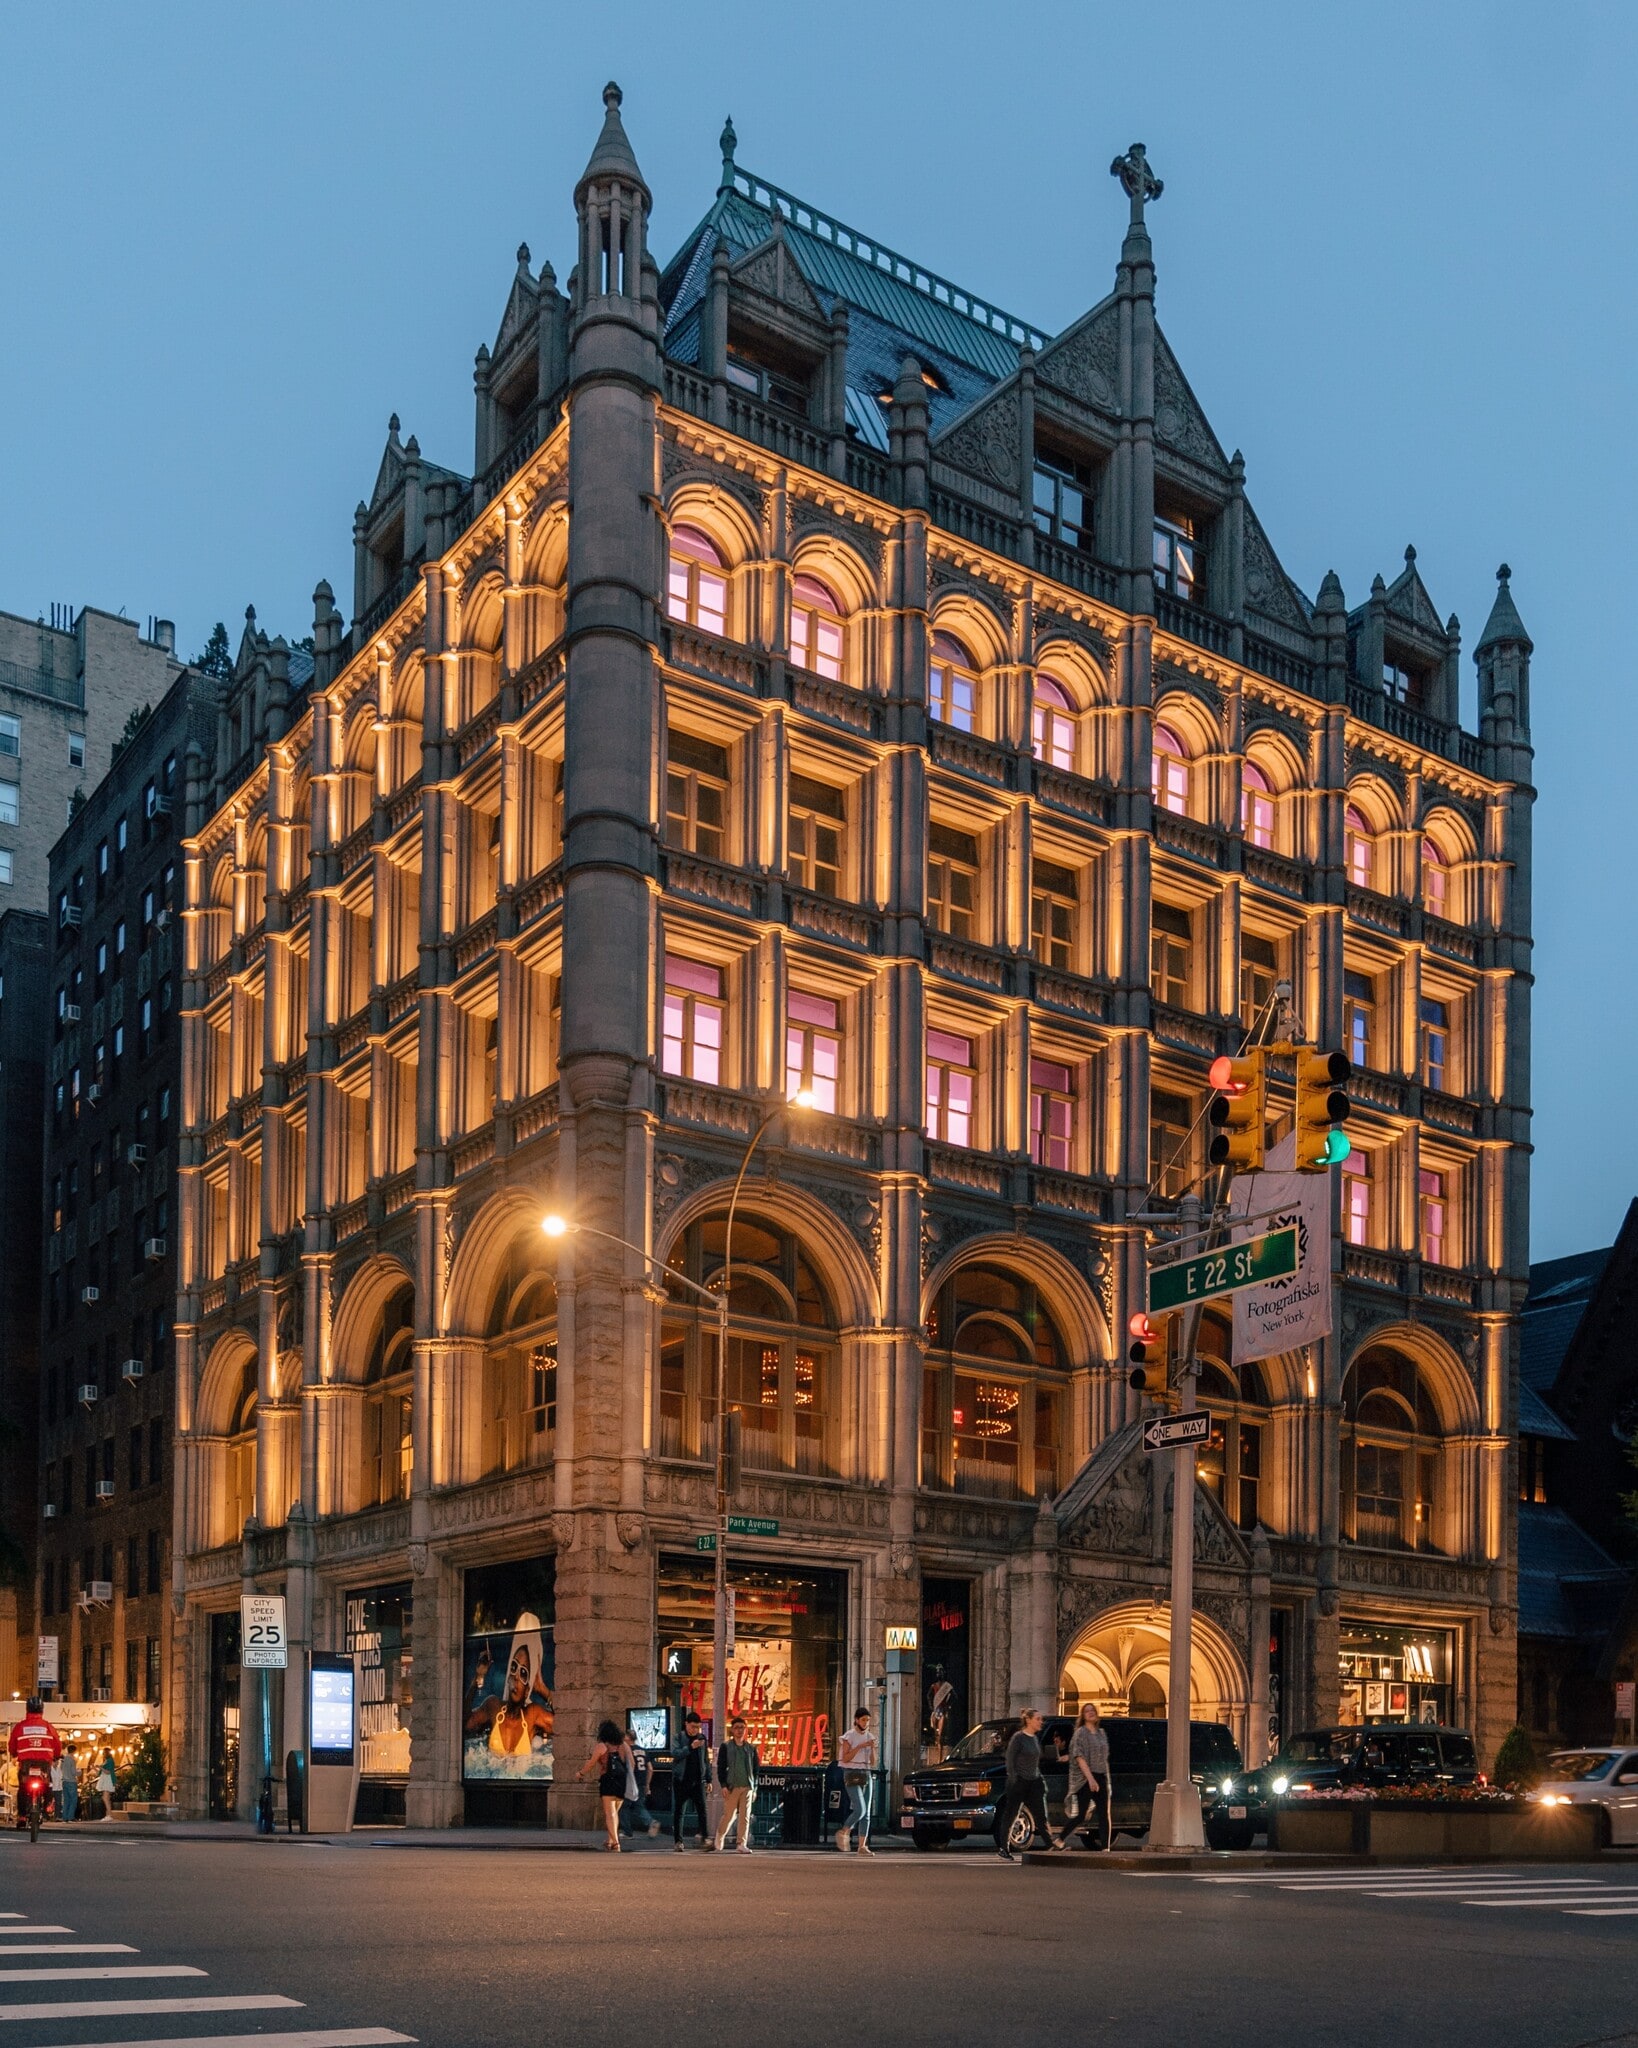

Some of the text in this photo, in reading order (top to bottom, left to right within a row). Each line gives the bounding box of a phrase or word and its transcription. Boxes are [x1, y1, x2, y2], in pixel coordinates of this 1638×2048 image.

[1186, 1250, 1253, 1295] E 22 St
[1247, 1281, 1320, 1319] Fotografiska
[1262, 1309, 1305, 1334] New York
[1151, 1420, 1204, 1440] ONE WAY
[729, 1517, 777, 1530] Park Avenue
[698, 1537, 703, 1550] E
[703, 1536, 710, 1549] 22
[250, 1607, 275, 1615] SPEED
[347, 1599, 367, 1633] FIVE
[249, 1625, 280, 1644] 25
[361, 1668, 386, 1702] MIND
[360, 1703, 399, 1738] ANDING
[756, 1774, 786, 1787] ubwa
